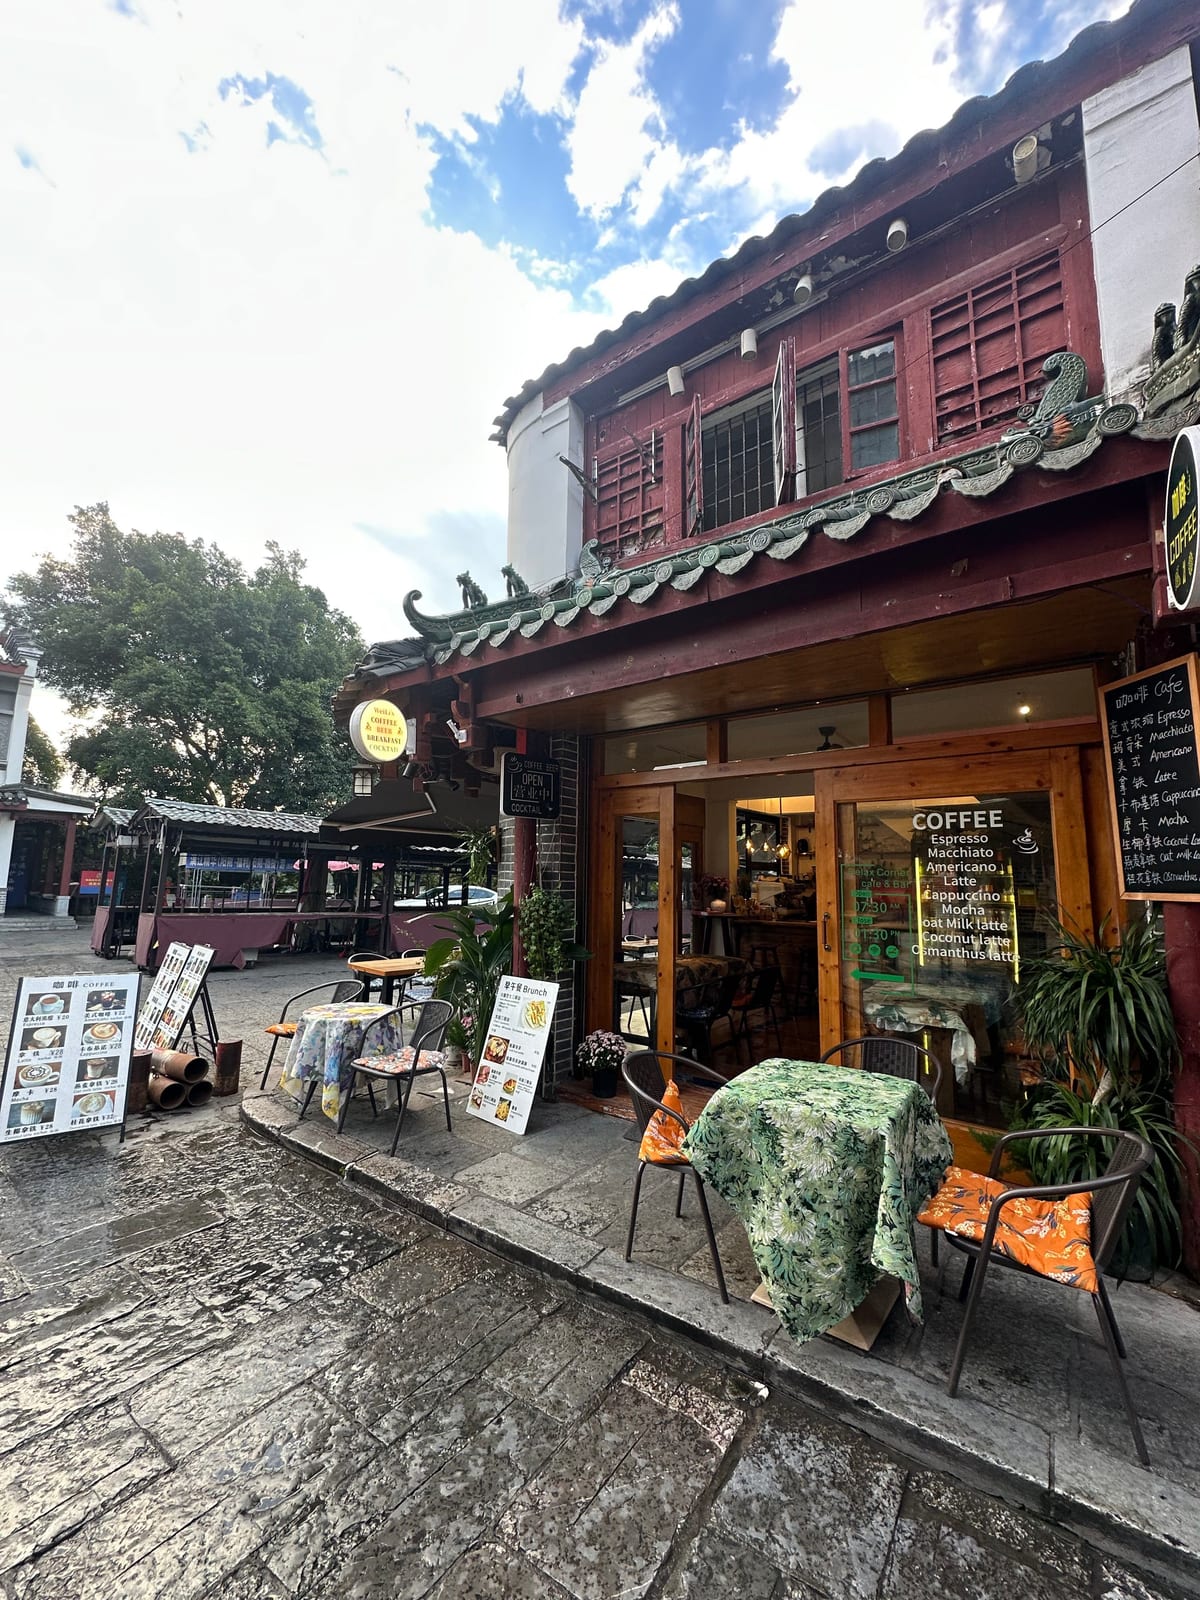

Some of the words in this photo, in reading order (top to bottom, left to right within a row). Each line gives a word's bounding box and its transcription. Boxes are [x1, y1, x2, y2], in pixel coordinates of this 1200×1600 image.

[1169, 504, 1197, 565] COFFEE
[1115, 684, 1149, 709] 咖啡
[1154, 674, 1184, 704] Cafe
[370, 716, 397, 726] COFFEE
[1157, 708, 1191, 726] Espresso
[366, 734, 401, 744] BREAKFAST
[1149, 724, 1194, 743] Macchiato
[1116, 754, 1141, 774] 美式
[1149, 746, 1193, 762] Americano
[522, 773, 544, 786] OPEN
[1154, 770, 1179, 783] Latte
[912, 810, 1003, 830] COFFEE
[1158, 810, 1190, 827] Mocha
[931, 833, 989, 846] Espresso
[927, 847, 994, 858] Macchiato
[876, 868, 910, 877] Corner
[926, 861, 997, 872] Americano
[884, 880, 890, 888] &
[943, 875, 977, 887] Latte
[924, 889, 1001, 904] Cappuccino
[855, 901, 887, 913] 07:30
[941, 904, 985, 916] Mocha
[922, 919, 943, 928] oat
[946, 918, 973, 930] Milk
[977, 920, 1008, 932] latte
[921, 931, 976, 945] Coconut
[979, 933, 1011, 946] latte
[911, 943, 986, 960] Osmanthus
[988, 948, 1021, 963] latte
[52, 980, 79, 989] 咖啡
[503, 981, 523, 992] 早午餐
[522, 985, 548, 997] Brunch
